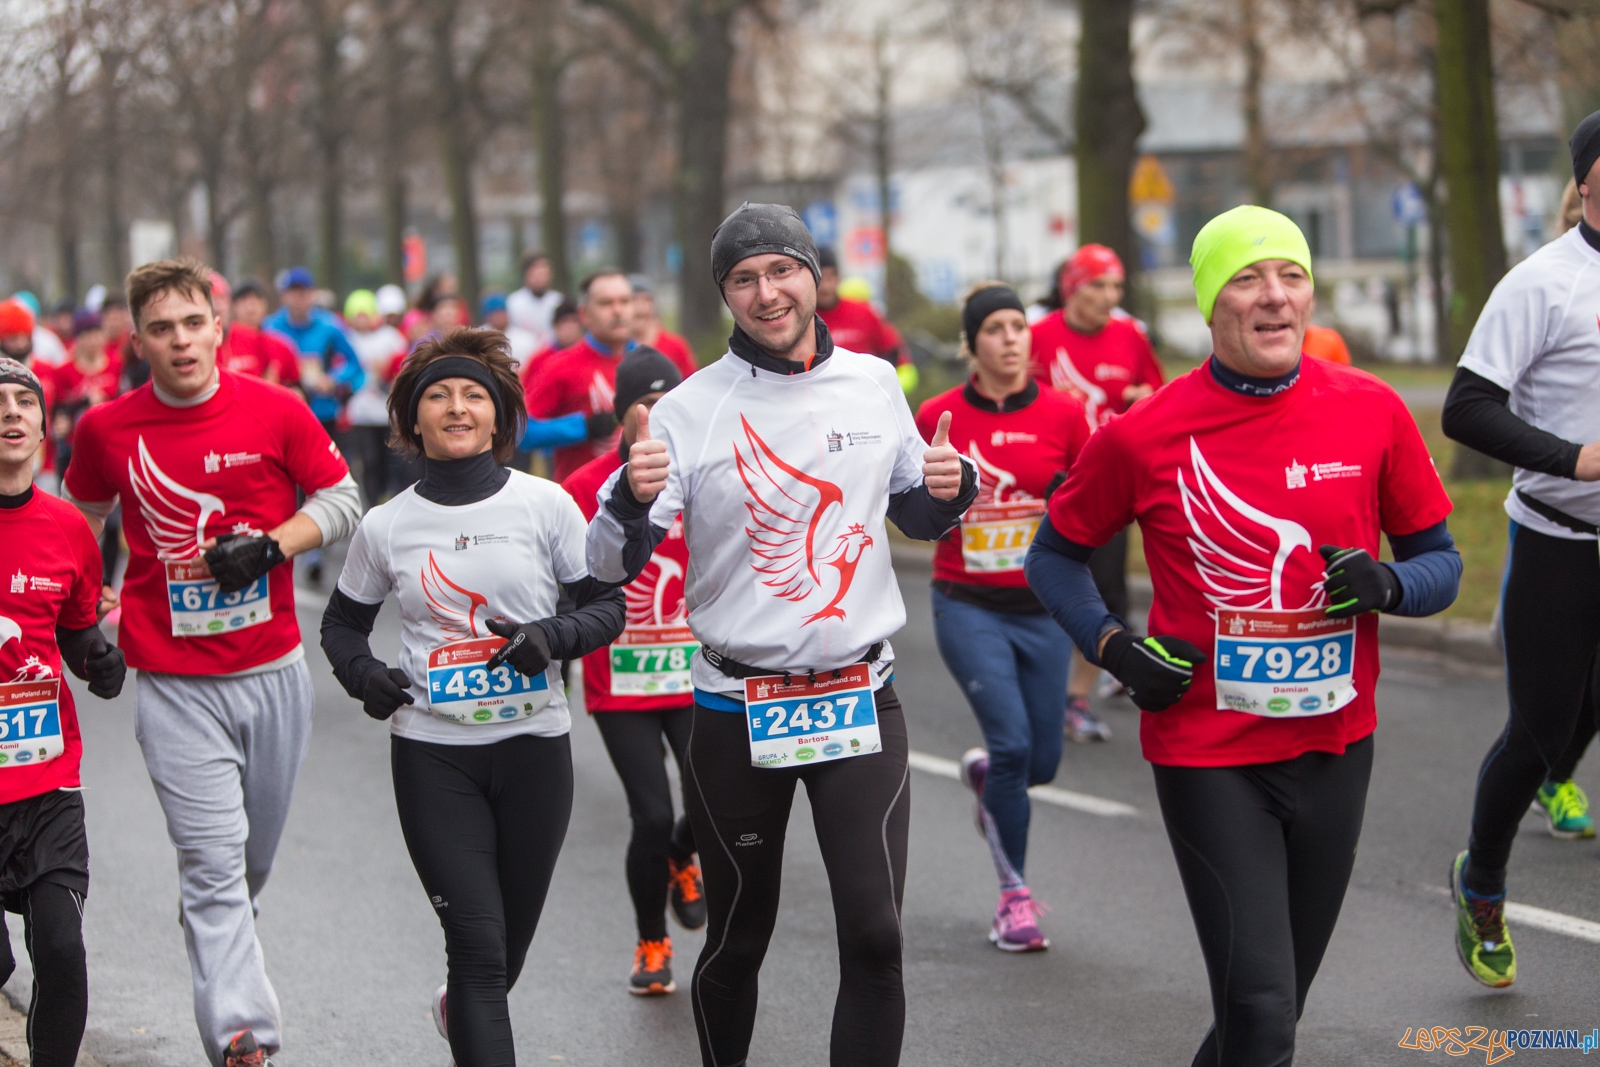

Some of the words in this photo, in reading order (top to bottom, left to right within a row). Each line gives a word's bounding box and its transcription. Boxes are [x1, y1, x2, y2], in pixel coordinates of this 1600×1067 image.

[1310, 463, 1323, 481] 1
[982, 525, 1033, 549] 777
[632, 648, 687, 672] 778
[1220, 654, 1231, 667] E
[1236, 641, 1341, 680] 7928
[432, 682, 441, 692] E
[444, 666, 531, 698] 4331
[813, 675, 862, 689] RunPoland.org
[1273, 686, 1309, 694] Damian
[11, 690, 52, 700] RunPoland.org
[752, 718, 762, 728] E
[765, 695, 859, 736] 2437
[798, 735, 829, 745] Bartosz
[758, 753, 778, 761] GRUPA
